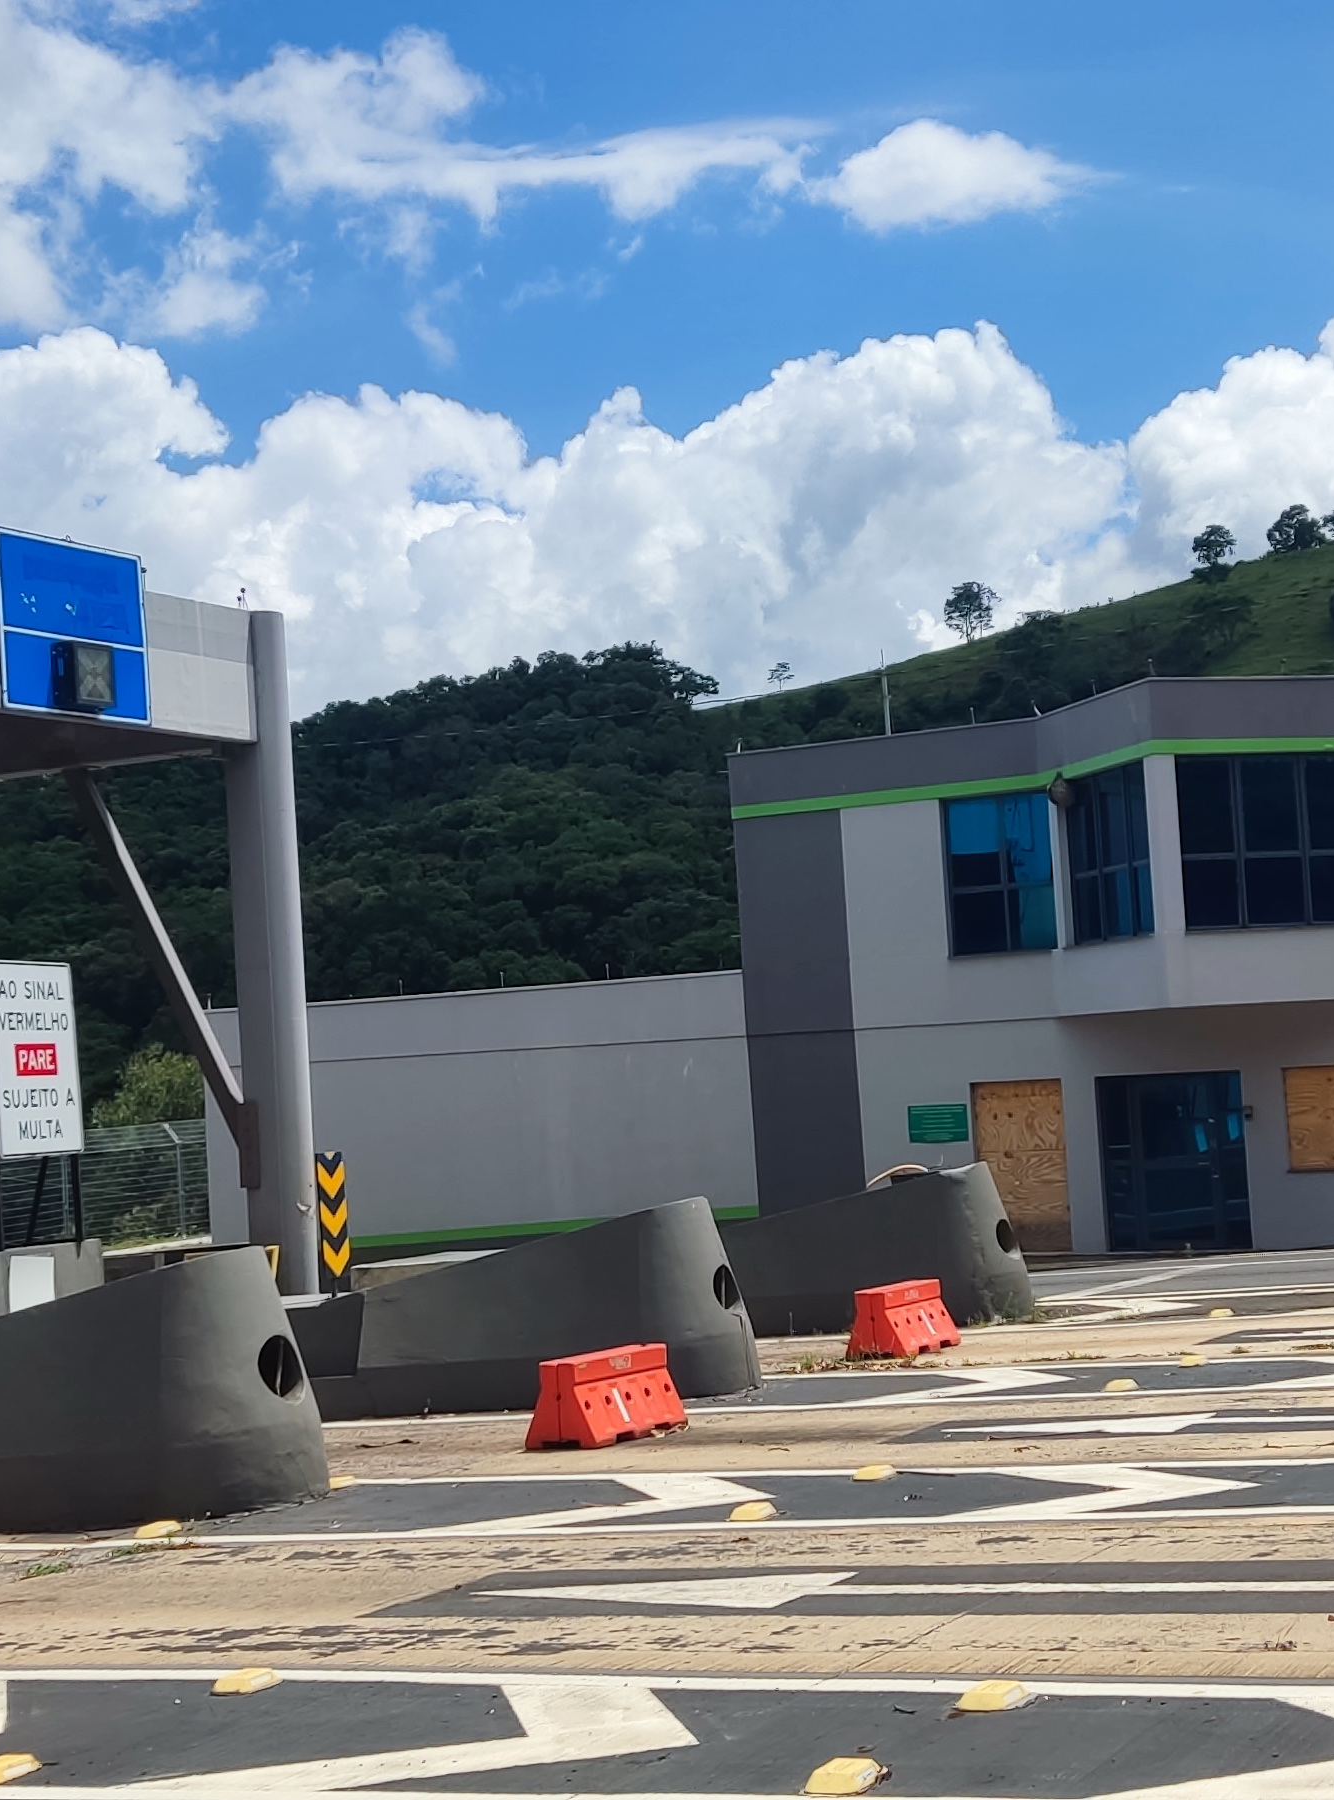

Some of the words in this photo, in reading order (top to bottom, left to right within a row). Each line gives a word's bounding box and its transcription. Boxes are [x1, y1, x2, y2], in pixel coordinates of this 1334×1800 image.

[24, 980, 65, 1001] SINAL
[17, 1048, 56, 1072] PARE
[2, 1087, 59, 1109] SUJEITO
[65, 1087, 76, 1107] A
[18, 1118, 64, 1140] MULTA
